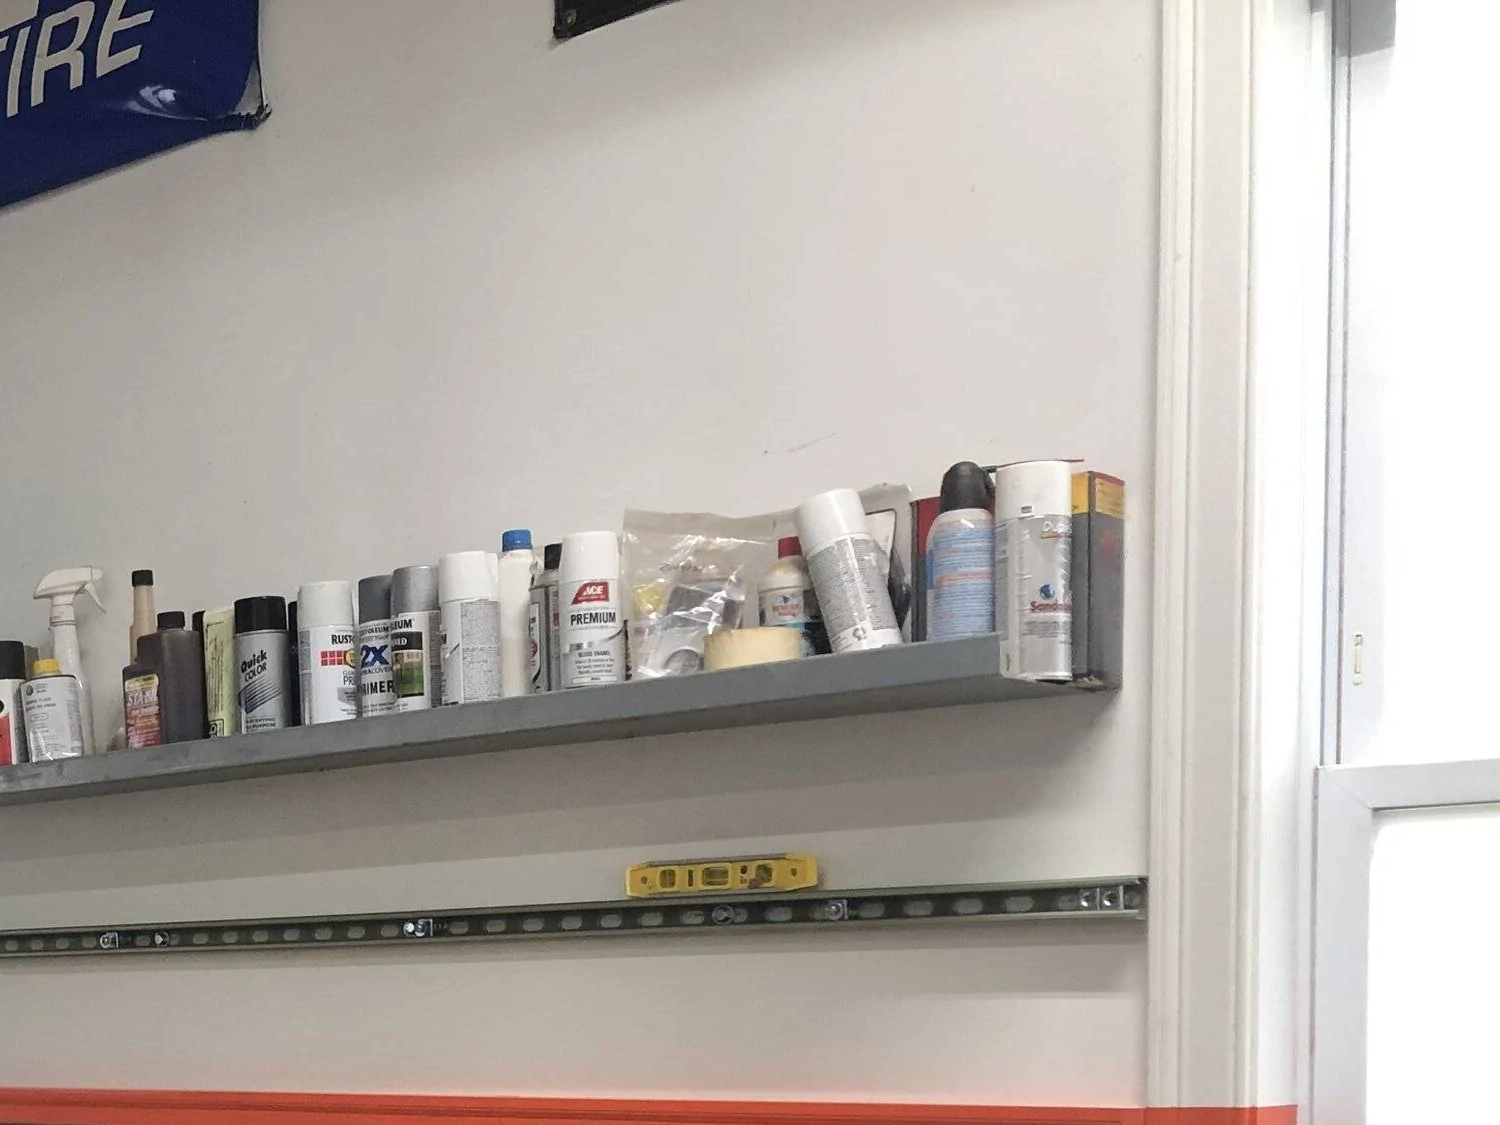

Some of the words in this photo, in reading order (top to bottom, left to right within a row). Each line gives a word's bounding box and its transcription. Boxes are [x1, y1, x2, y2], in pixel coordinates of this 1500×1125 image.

[583, 585, 604, 595] ACE
[570, 612, 616, 626] PREMIUM
[241, 650, 268, 673] Quick
[361, 644, 390, 668] 2X
[244, 662, 268, 682] COLOR
